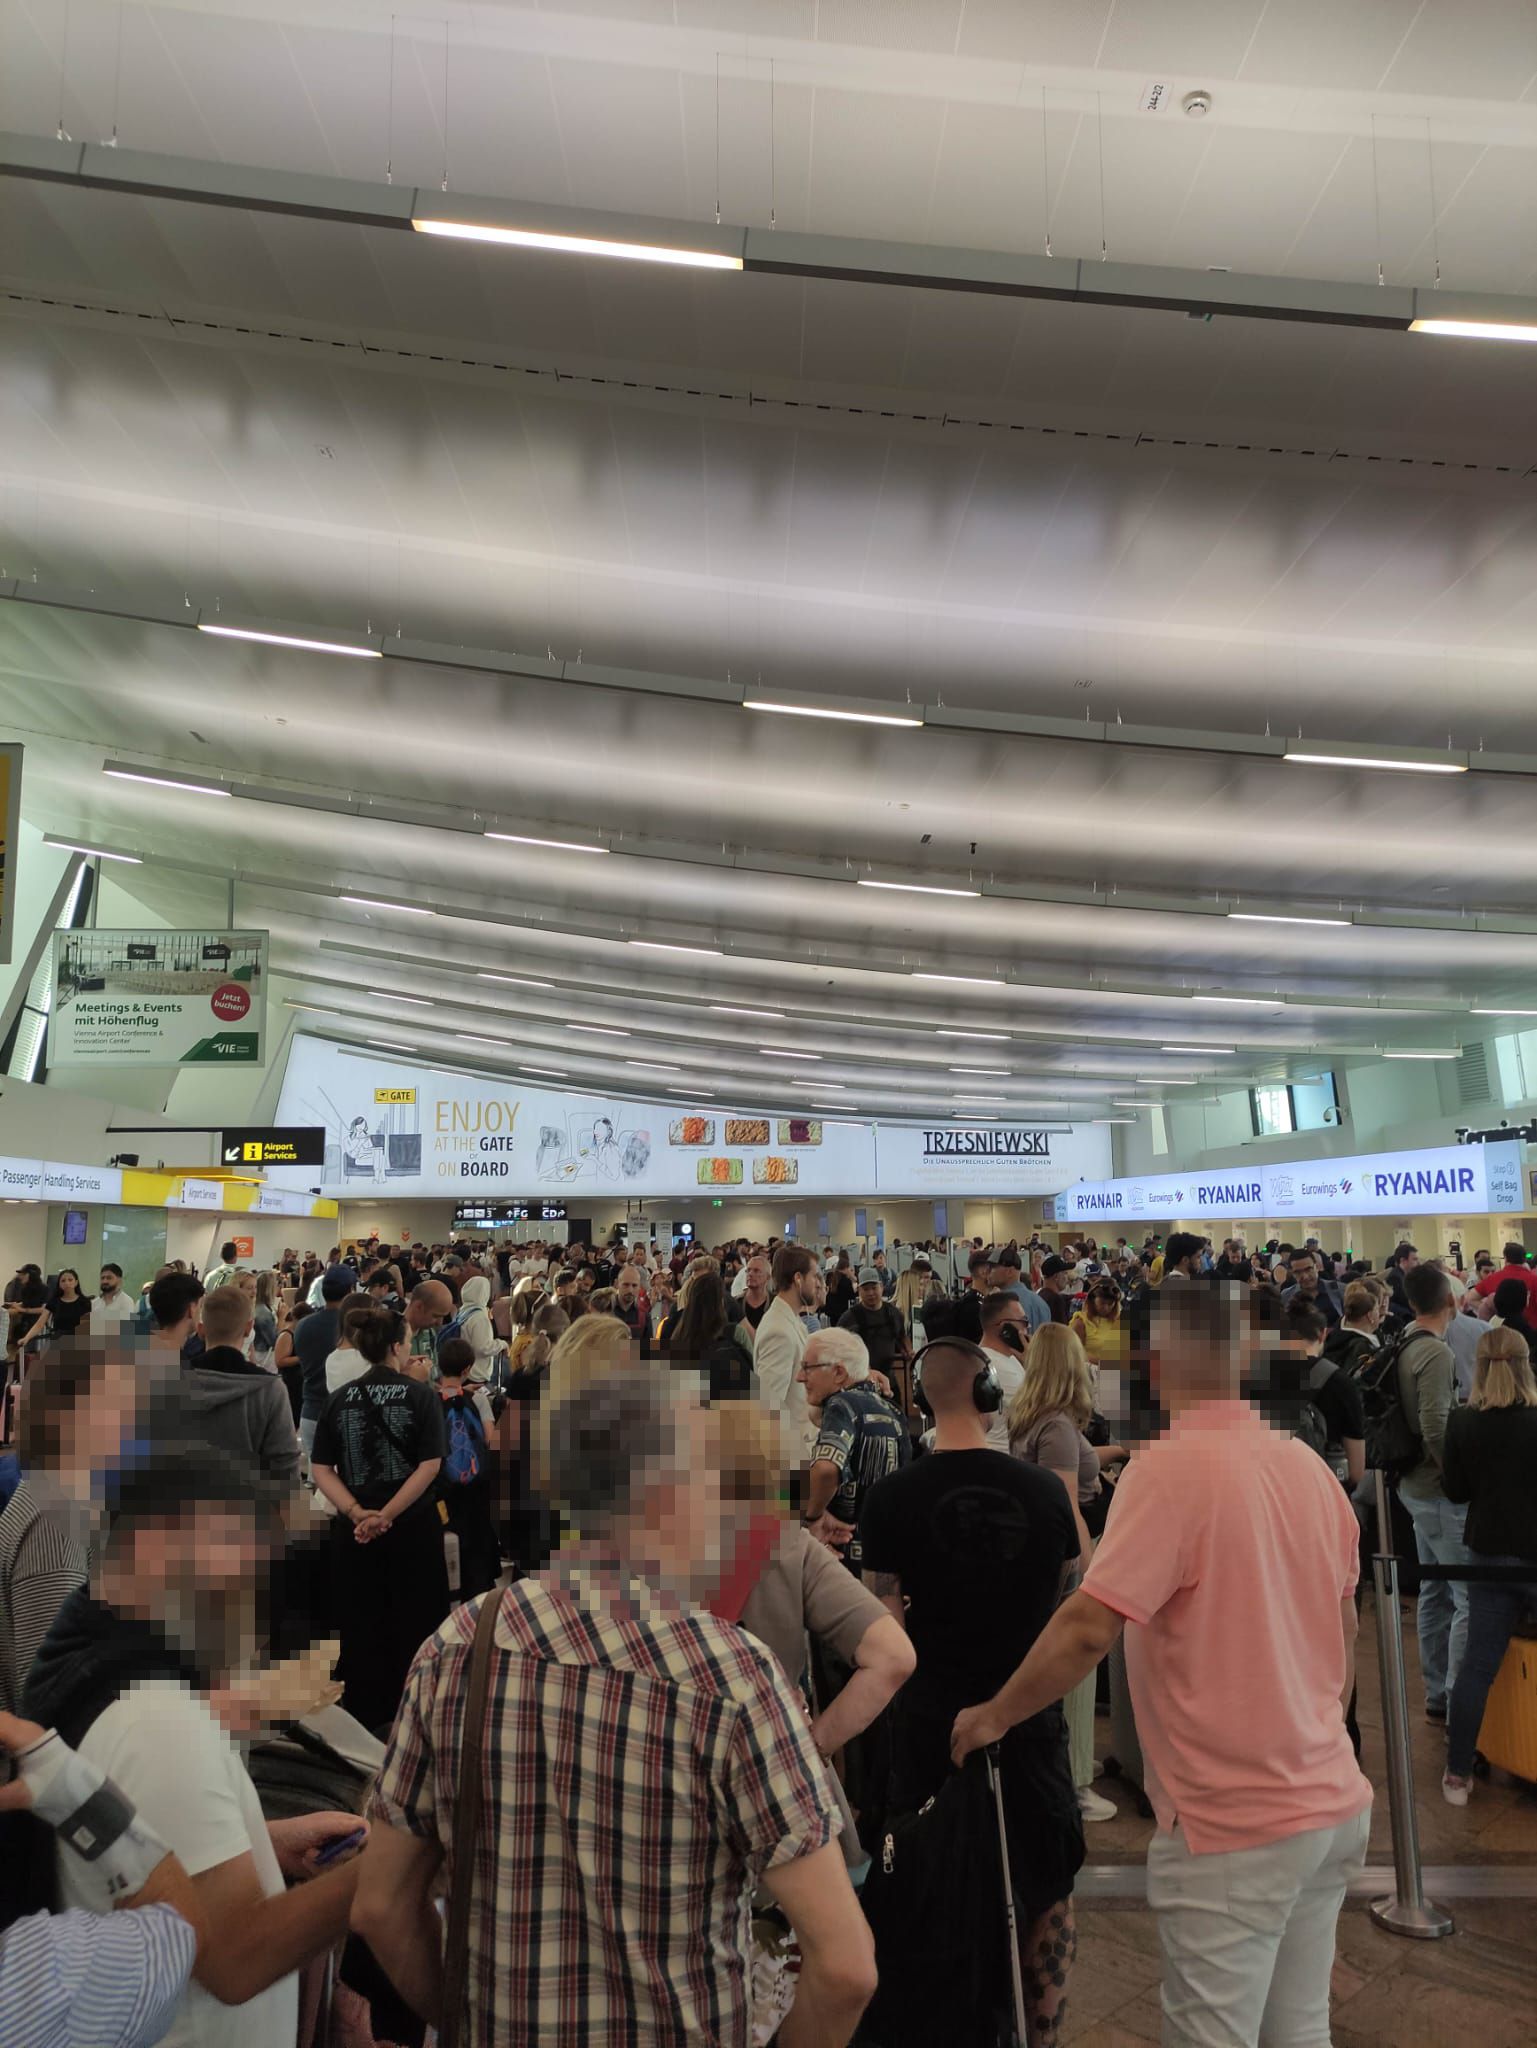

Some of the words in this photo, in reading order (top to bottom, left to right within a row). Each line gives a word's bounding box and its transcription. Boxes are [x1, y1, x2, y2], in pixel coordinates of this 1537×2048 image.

[221, 992, 241, 1003] Jetzt
[76, 1002, 130, 1014] Meetings
[132, 1003, 142, 1013] &
[144, 1003, 182, 1013] Events
[74, 1015, 95, 1025] mit
[98, 1014, 159, 1027] Höhenflug
[97, 1030, 120, 1038] Airport
[122, 1030, 158, 1038] Conference
[217, 1044, 236, 1054] VIE
[390, 1090, 411, 1102] GATE
[434, 1101, 520, 1132] ENJOY
[264, 1143, 294, 1152] Airport
[434, 1137, 450, 1151] AT
[453, 1137, 476, 1151] THE
[480, 1136, 514, 1152] GATE
[923, 1132, 1049, 1153] TRZESNIEWSKI
[264, 1152, 296, 1160] Services
[996, 1158, 1018, 1166] GUTEN
[438, 1162, 456, 1176] ON
[460, 1162, 508, 1176] BOARD
[2, 1169, 42, 1188] Passenger
[44, 1174, 74, 1191] Handling
[76, 1176, 100, 1190] Services
[1374, 1168, 1475, 1196] RYANAIR
[1302, 1182, 1338, 1197] Eurowings
[1491, 1181, 1504, 1192] Self
[1504, 1181, 1517, 1192] Bag
[1198, 1183, 1262, 1205] RYANAIR
[1496, 1194, 1514, 1204] Drop
[1076, 1192, 1123, 1210] RYANAIR
